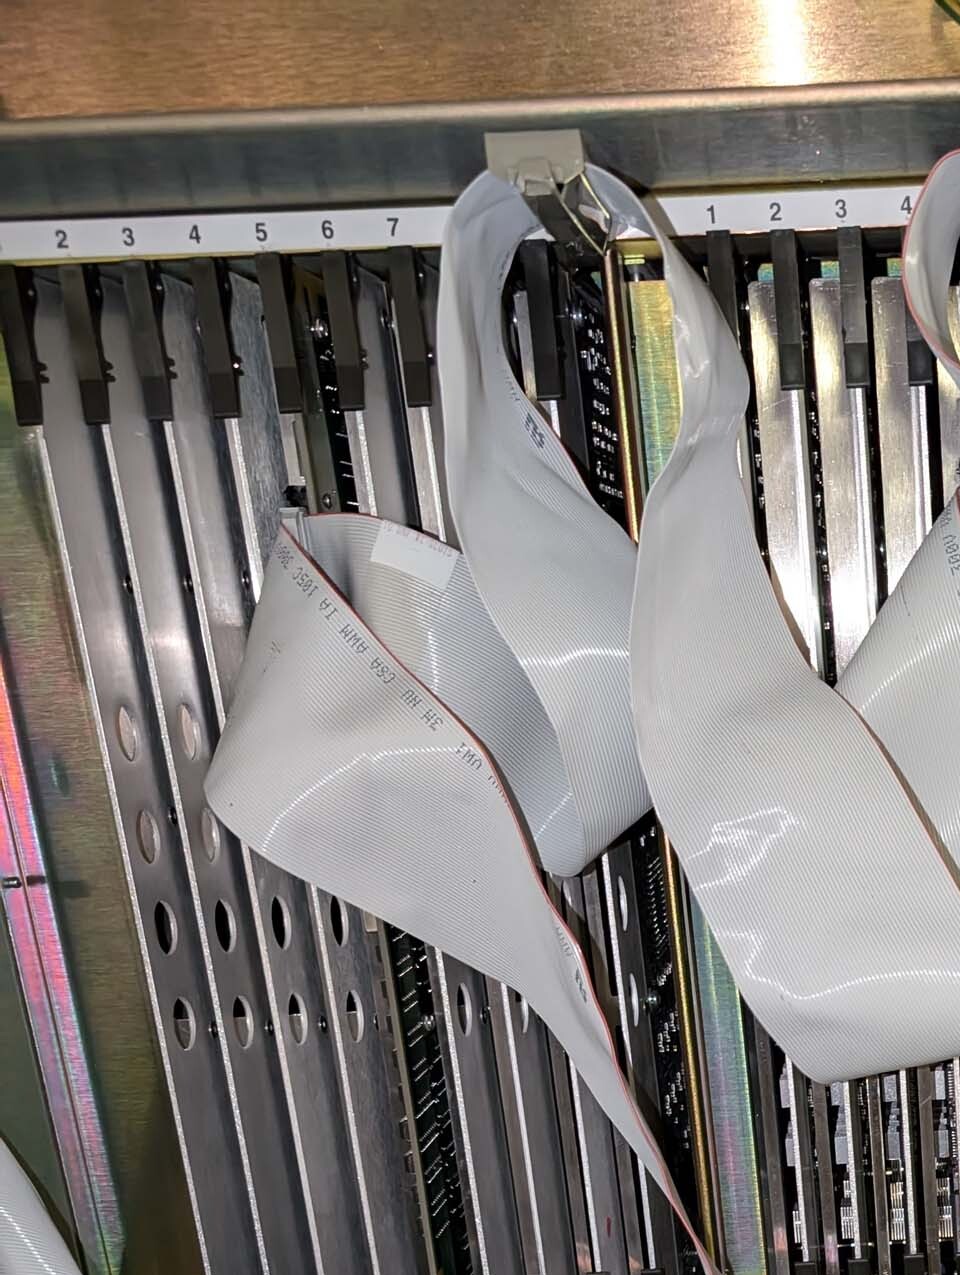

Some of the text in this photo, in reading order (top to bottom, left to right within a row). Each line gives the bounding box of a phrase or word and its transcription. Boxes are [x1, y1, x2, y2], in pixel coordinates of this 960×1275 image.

[706, 195, 913, 225] 1 2 3 4
[55, 217, 399, 249] 2 3 4 5 6 7
